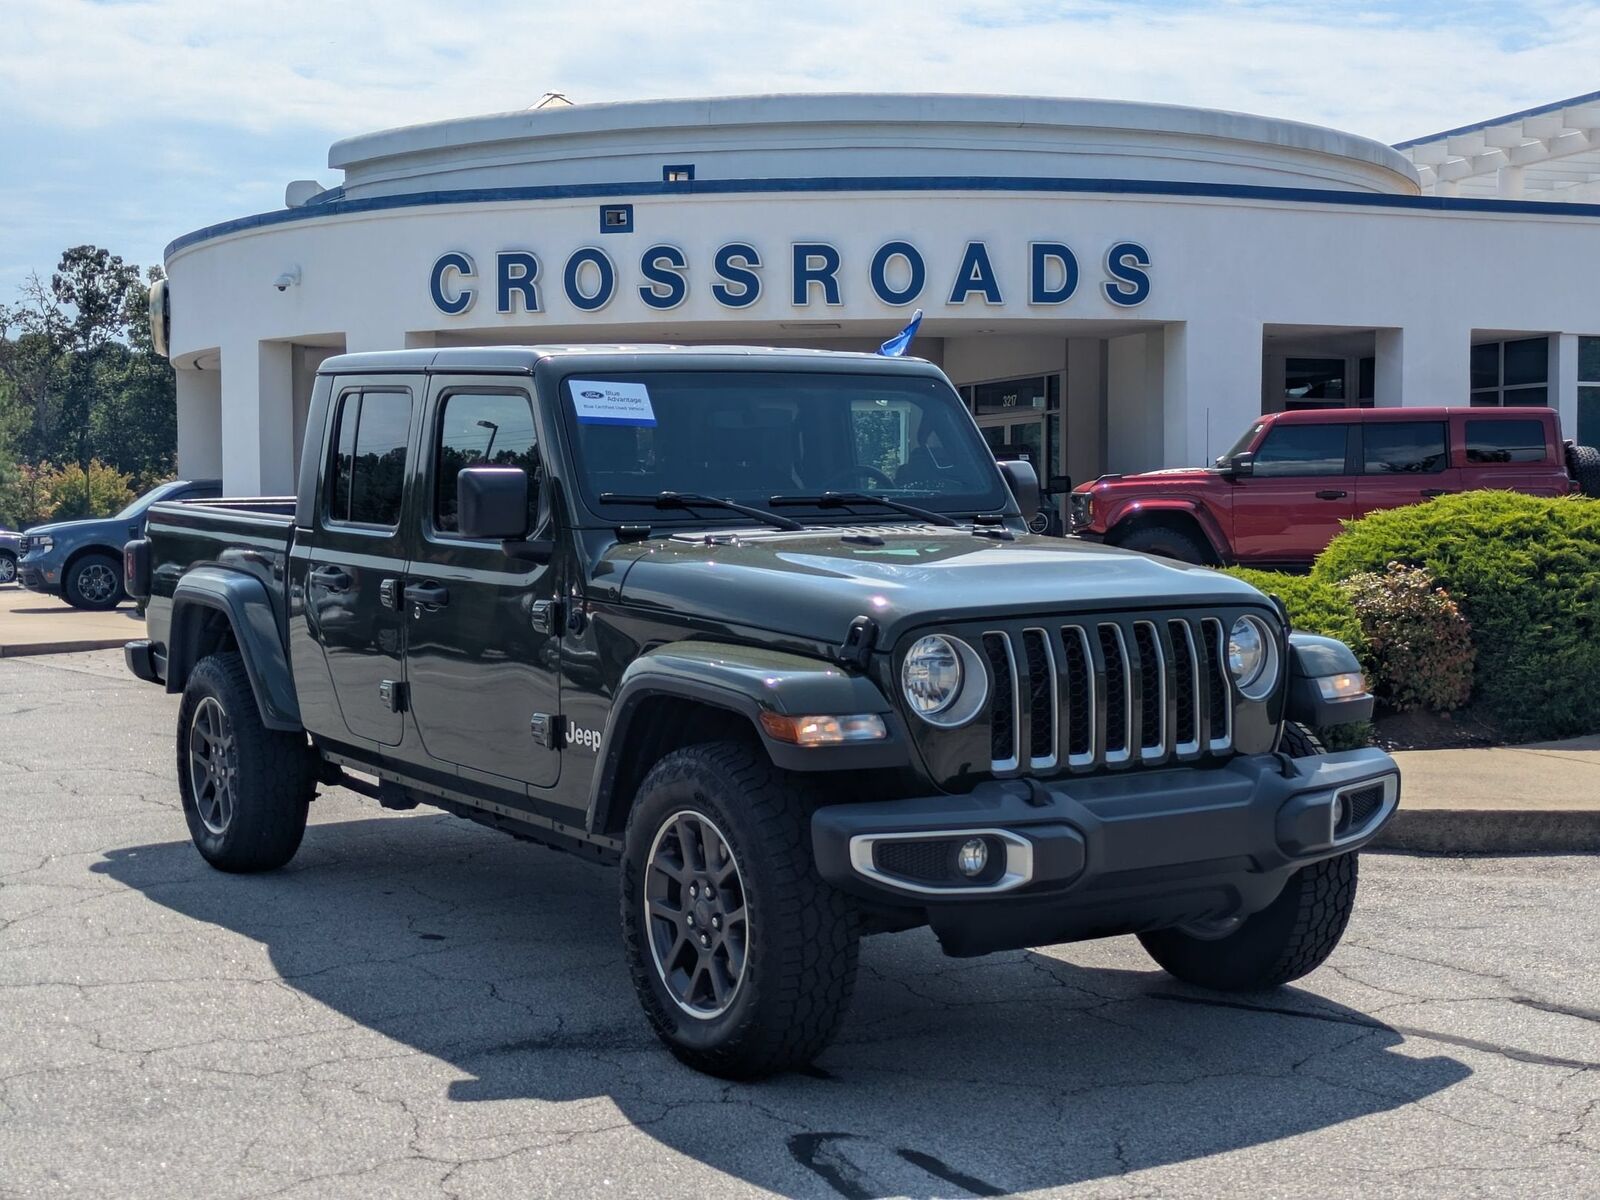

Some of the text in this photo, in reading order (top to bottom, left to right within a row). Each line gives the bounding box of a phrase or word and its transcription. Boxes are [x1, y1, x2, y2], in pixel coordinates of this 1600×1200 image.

[430, 241, 1155, 316] CROSSROADS
[584, 391, 601, 399] Ford
[607, 396, 642, 404] Advantage
[565, 721, 602, 752] Jeep
